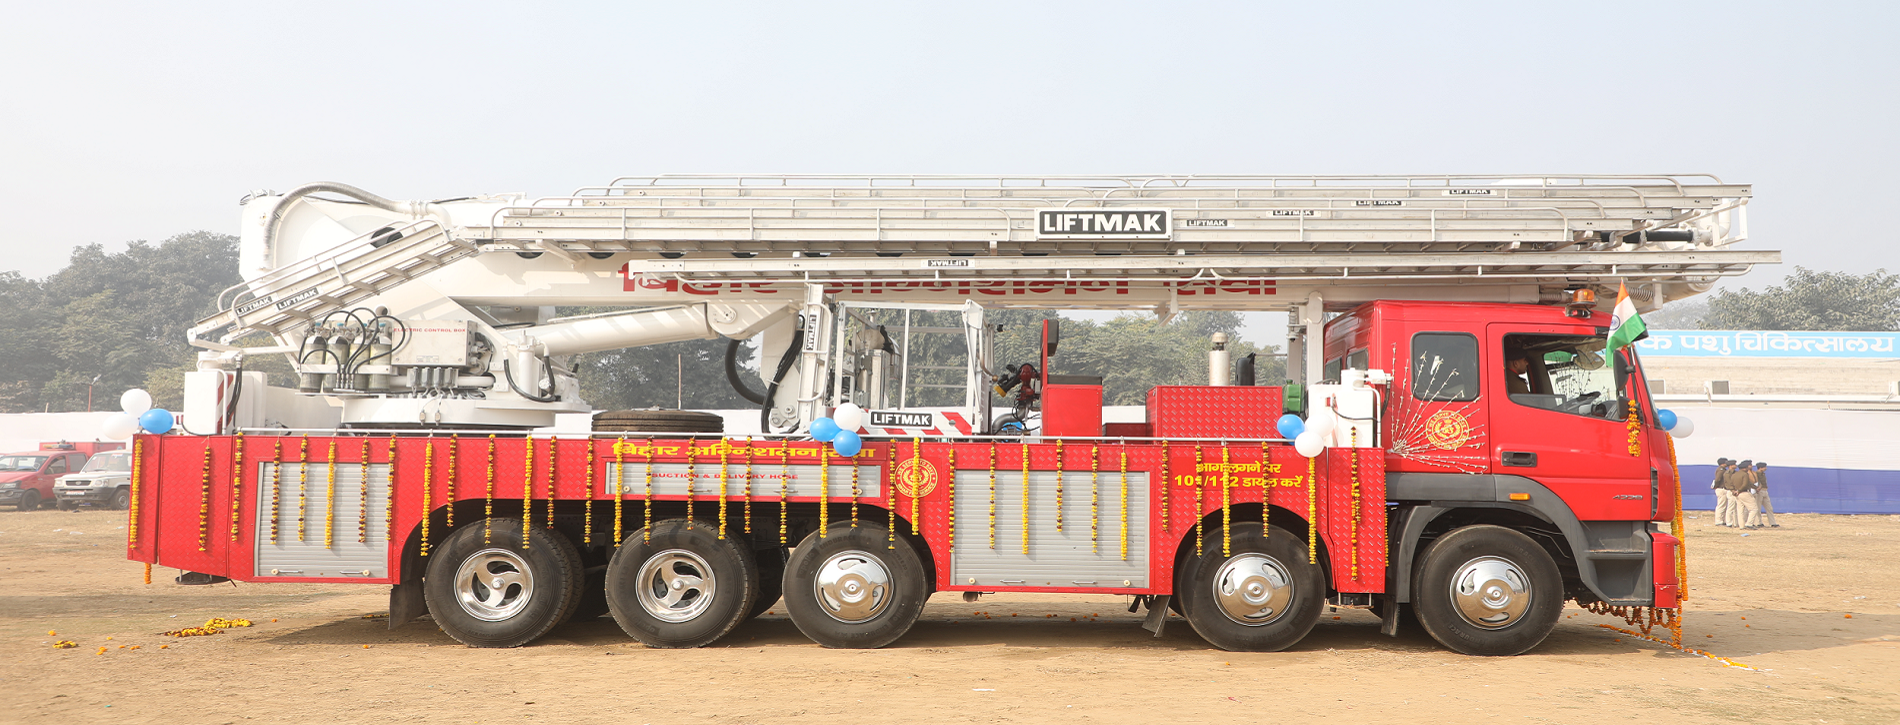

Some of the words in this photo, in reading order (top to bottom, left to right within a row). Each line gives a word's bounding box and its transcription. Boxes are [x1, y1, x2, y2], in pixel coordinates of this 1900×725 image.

[1043, 213, 1161, 232] LIFTMAK
[236, 297, 271, 315] LIFTMAK
[278, 289, 317, 310] LIFTMAK
[806, 315, 817, 351] LIFTMAK
[1679, 335, 1731, 355] पशु
[1733, 332, 1895, 353] चिकित्सालय
[873, 413, 931, 425] LIFTMAK
[611, 442, 681, 455] बिहार
[1280, 475, 1304, 488] करें
